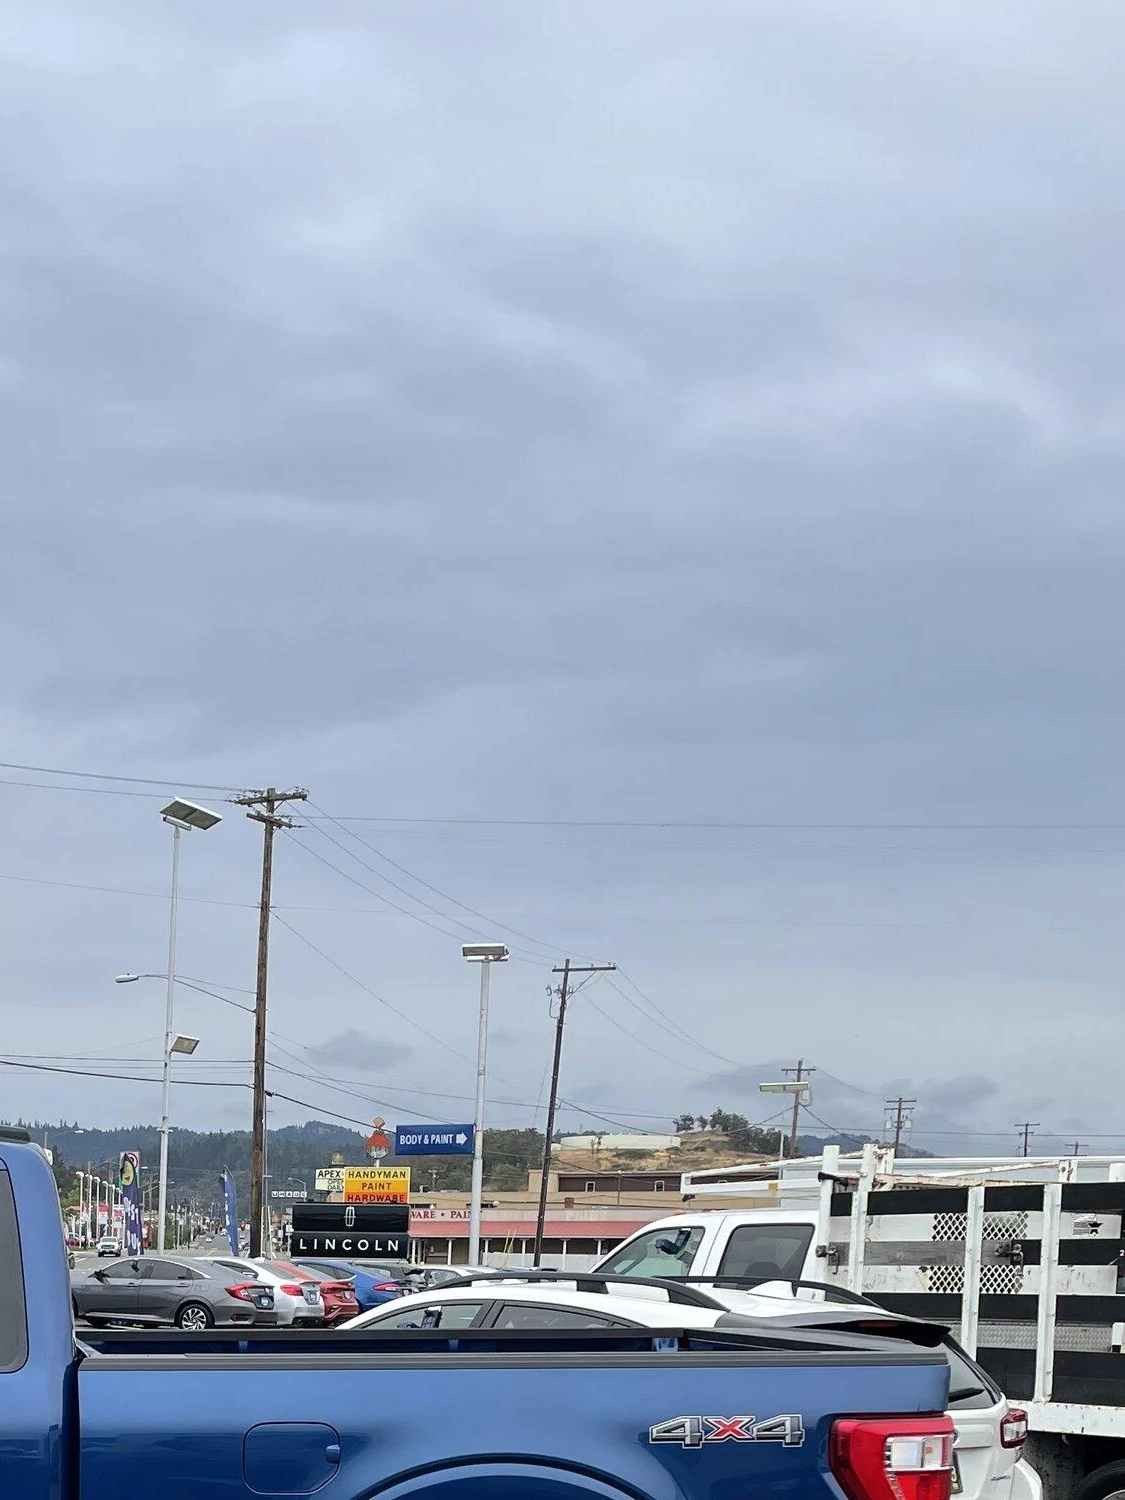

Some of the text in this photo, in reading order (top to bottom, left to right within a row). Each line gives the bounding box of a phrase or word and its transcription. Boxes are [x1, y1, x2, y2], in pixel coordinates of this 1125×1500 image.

[399, 1133, 454, 1145] BODY & PAINT
[317, 1169, 342, 1179] APEX
[348, 1170, 407, 1180] HANDYMAN
[361, 1182, 392, 1191] PAINT
[347, 1194, 406, 1203] HARDWARE
[299, 1238, 399, 1252] LINCOLN
